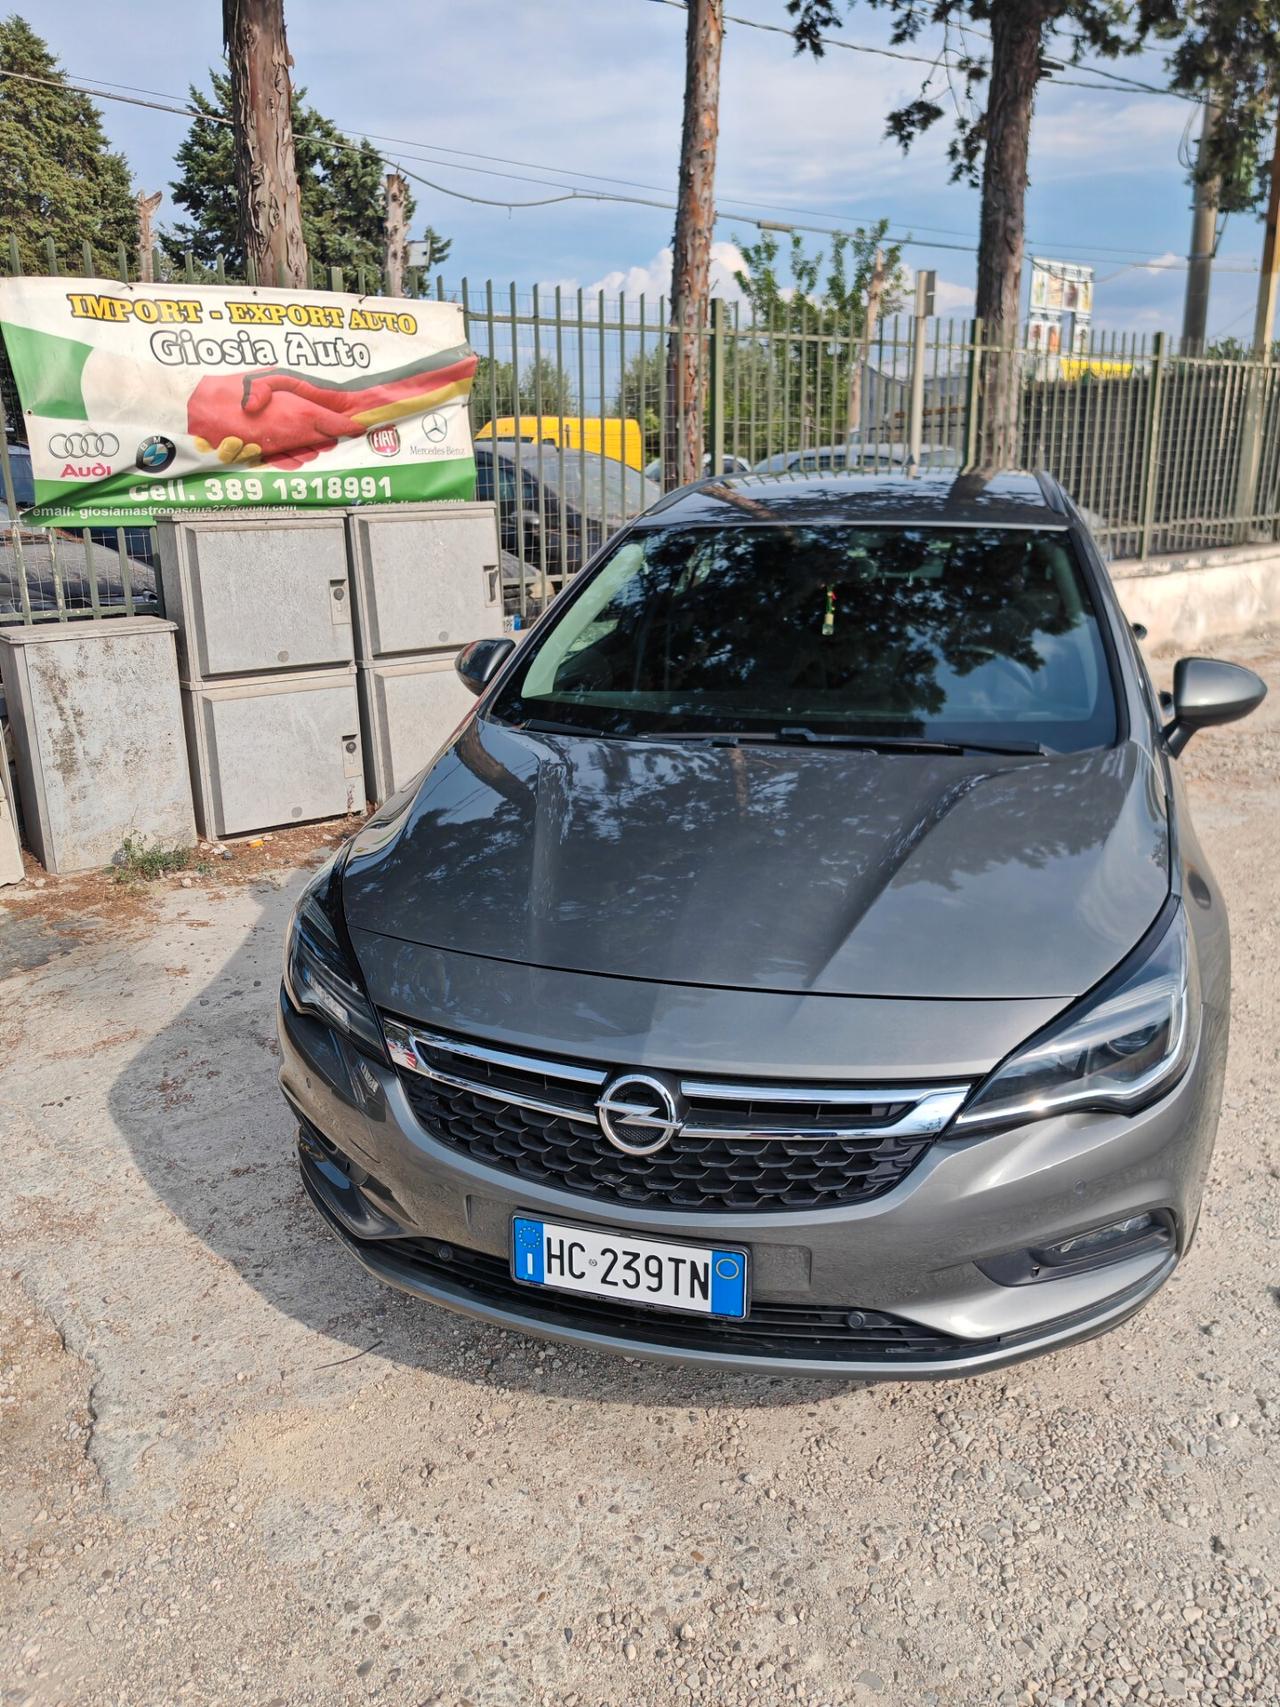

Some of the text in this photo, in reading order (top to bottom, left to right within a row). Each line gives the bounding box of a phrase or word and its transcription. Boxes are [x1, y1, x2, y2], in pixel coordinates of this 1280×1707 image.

[67, 293, 203, 323] IMPORT
[225, 301, 345, 329] EXPORT
[348, 311, 418, 336] AUTO
[151, 330, 371, 369] Giosia Auto
[373, 430, 395, 448] FIAT
[60, 462, 112, 478] Audi
[129, 477, 392, 501] Cell. 389 1318991
[546, 1237, 710, 1301] HC 239TN
